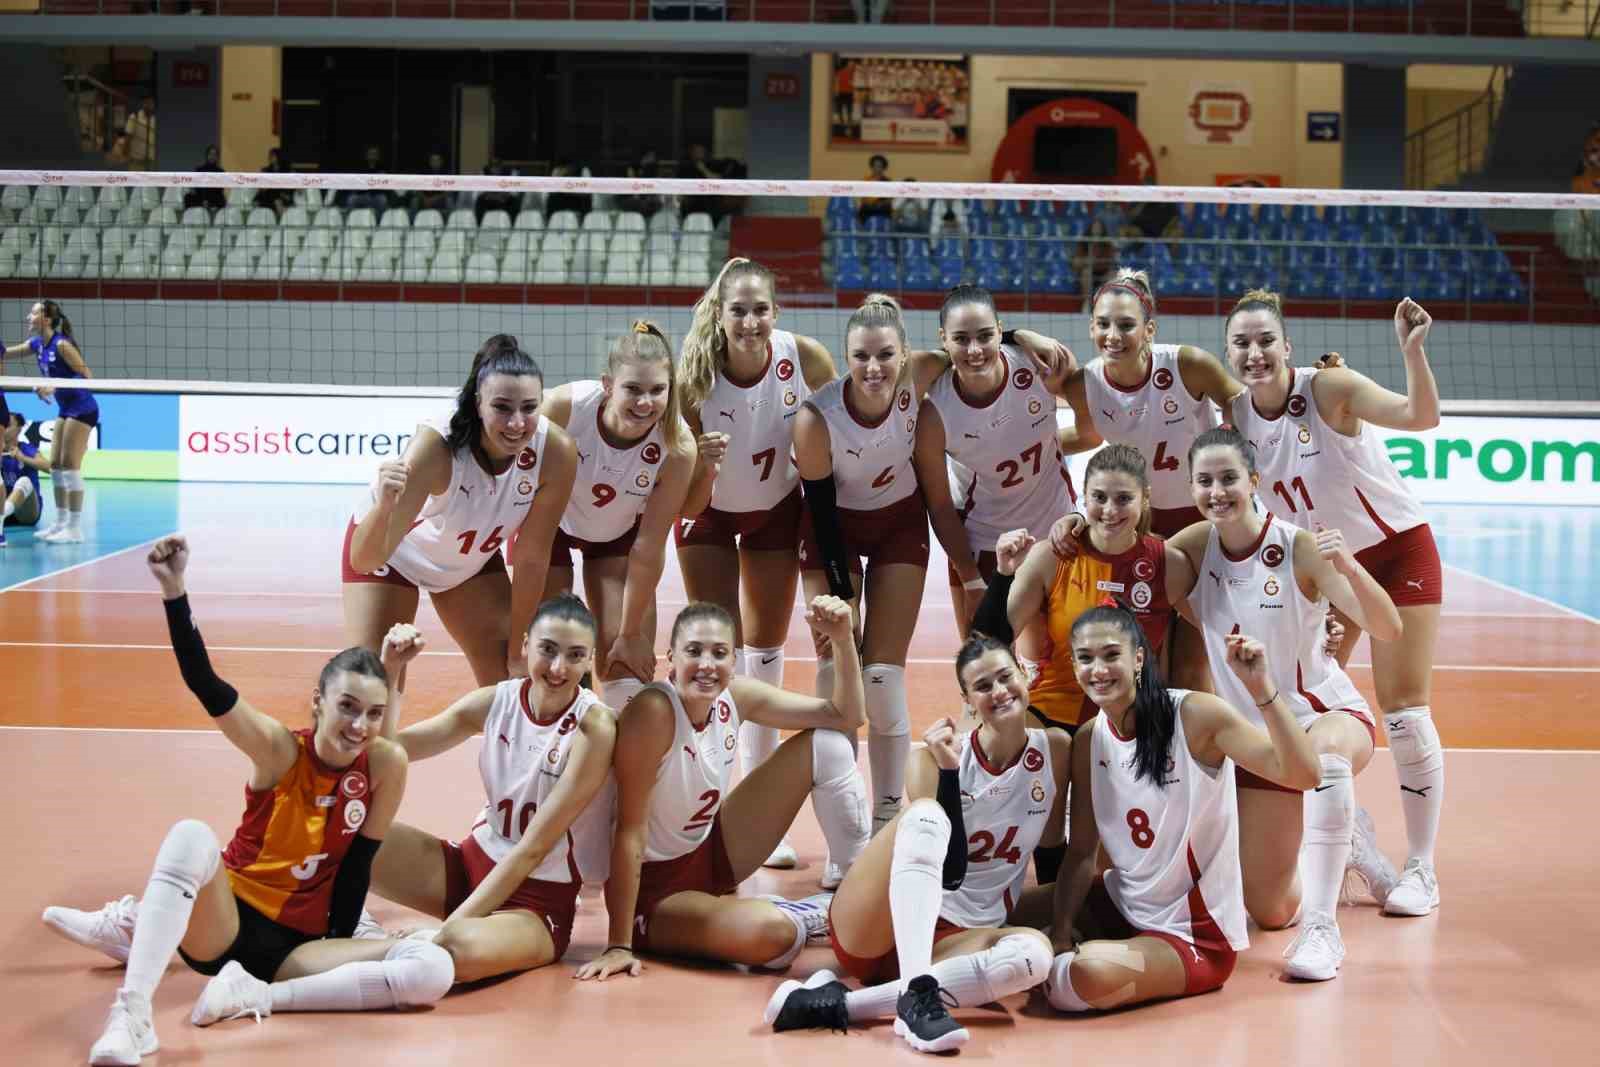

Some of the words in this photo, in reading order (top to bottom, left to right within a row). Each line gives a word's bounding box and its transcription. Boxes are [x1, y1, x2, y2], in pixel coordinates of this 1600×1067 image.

[752, 447, 776, 482] 7
[996, 441, 1043, 489] 27
[1153, 441, 1180, 471] 4
[1384, 437, 1600, 482] arom
[591, 483, 617, 508] 9
[1273, 476, 1315, 513] 11
[457, 525, 505, 555] 16
[682, 517, 697, 539] 7
[685, 789, 721, 831] 2
[968, 826, 1021, 864] 24
[1126, 808, 1155, 850] 8
